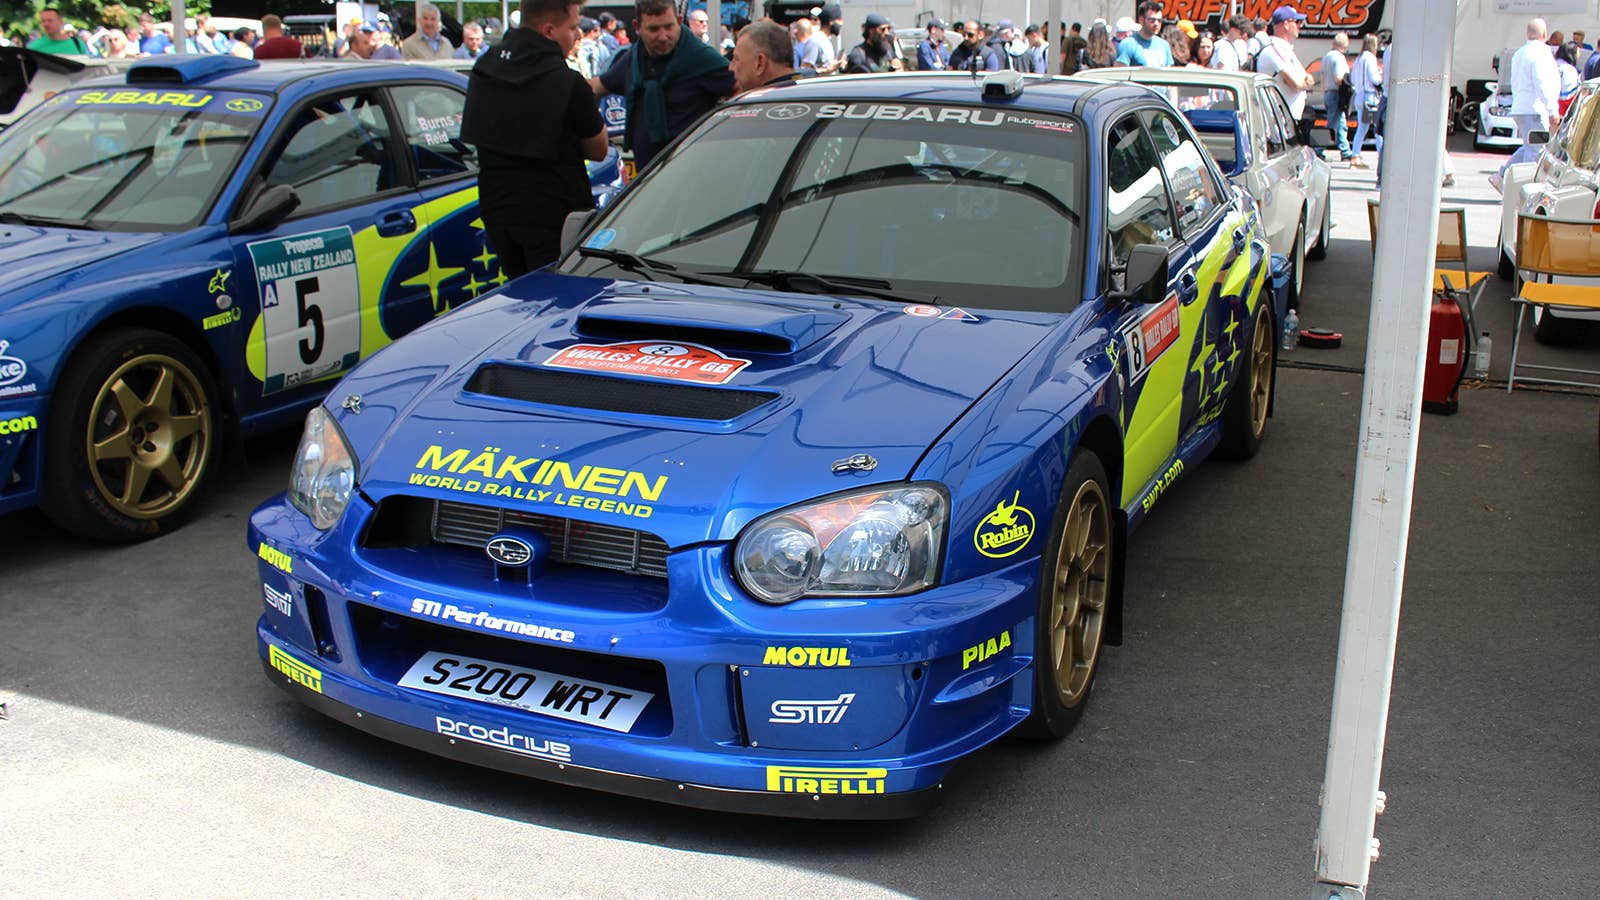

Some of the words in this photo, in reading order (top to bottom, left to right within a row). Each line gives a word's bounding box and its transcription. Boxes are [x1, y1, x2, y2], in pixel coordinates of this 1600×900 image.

[1150, 0, 1369, 25] DRIFTWRKS
[75, 91, 213, 107] SUBARU
[417, 115, 454, 131] Burns
[815, 104, 1005, 126] SUBARU
[424, 130, 449, 146] Reid
[258, 261, 289, 281] RALLY
[290, 258, 312, 274] NEW
[313, 248, 354, 269] ZEALAND
[264, 284, 277, 306] A
[295, 276, 325, 365] 5
[566, 348, 636, 362] WALES
[635, 355, 700, 369] RALLY
[699, 361, 734, 374] GB
[651, 346, 674, 355] 8
[1131, 331, 1142, 372] 8
[588, 361, 648, 372] SEPTEMBER
[415, 444, 669, 502] MÄKINEN
[1142, 459, 1184, 513] swrt.com
[408, 473, 481, 493] WORLD
[482, 483, 552, 502] RALLY
[553, 494, 653, 519] LEGEND
[980, 523, 1029, 549] Robin
[258, 542, 293, 574] MOTUL
[441, 604, 576, 643] Performance
[762, 646, 851, 667] MOTUL
[962, 630, 1012, 670] PIAA
[268, 643, 323, 694] PIRELLI
[423, 658, 537, 700] S200
[540, 680, 633, 720] WRT
[435, 716, 572, 757] prodrive
[766, 765, 888, 794] PIRELLI
